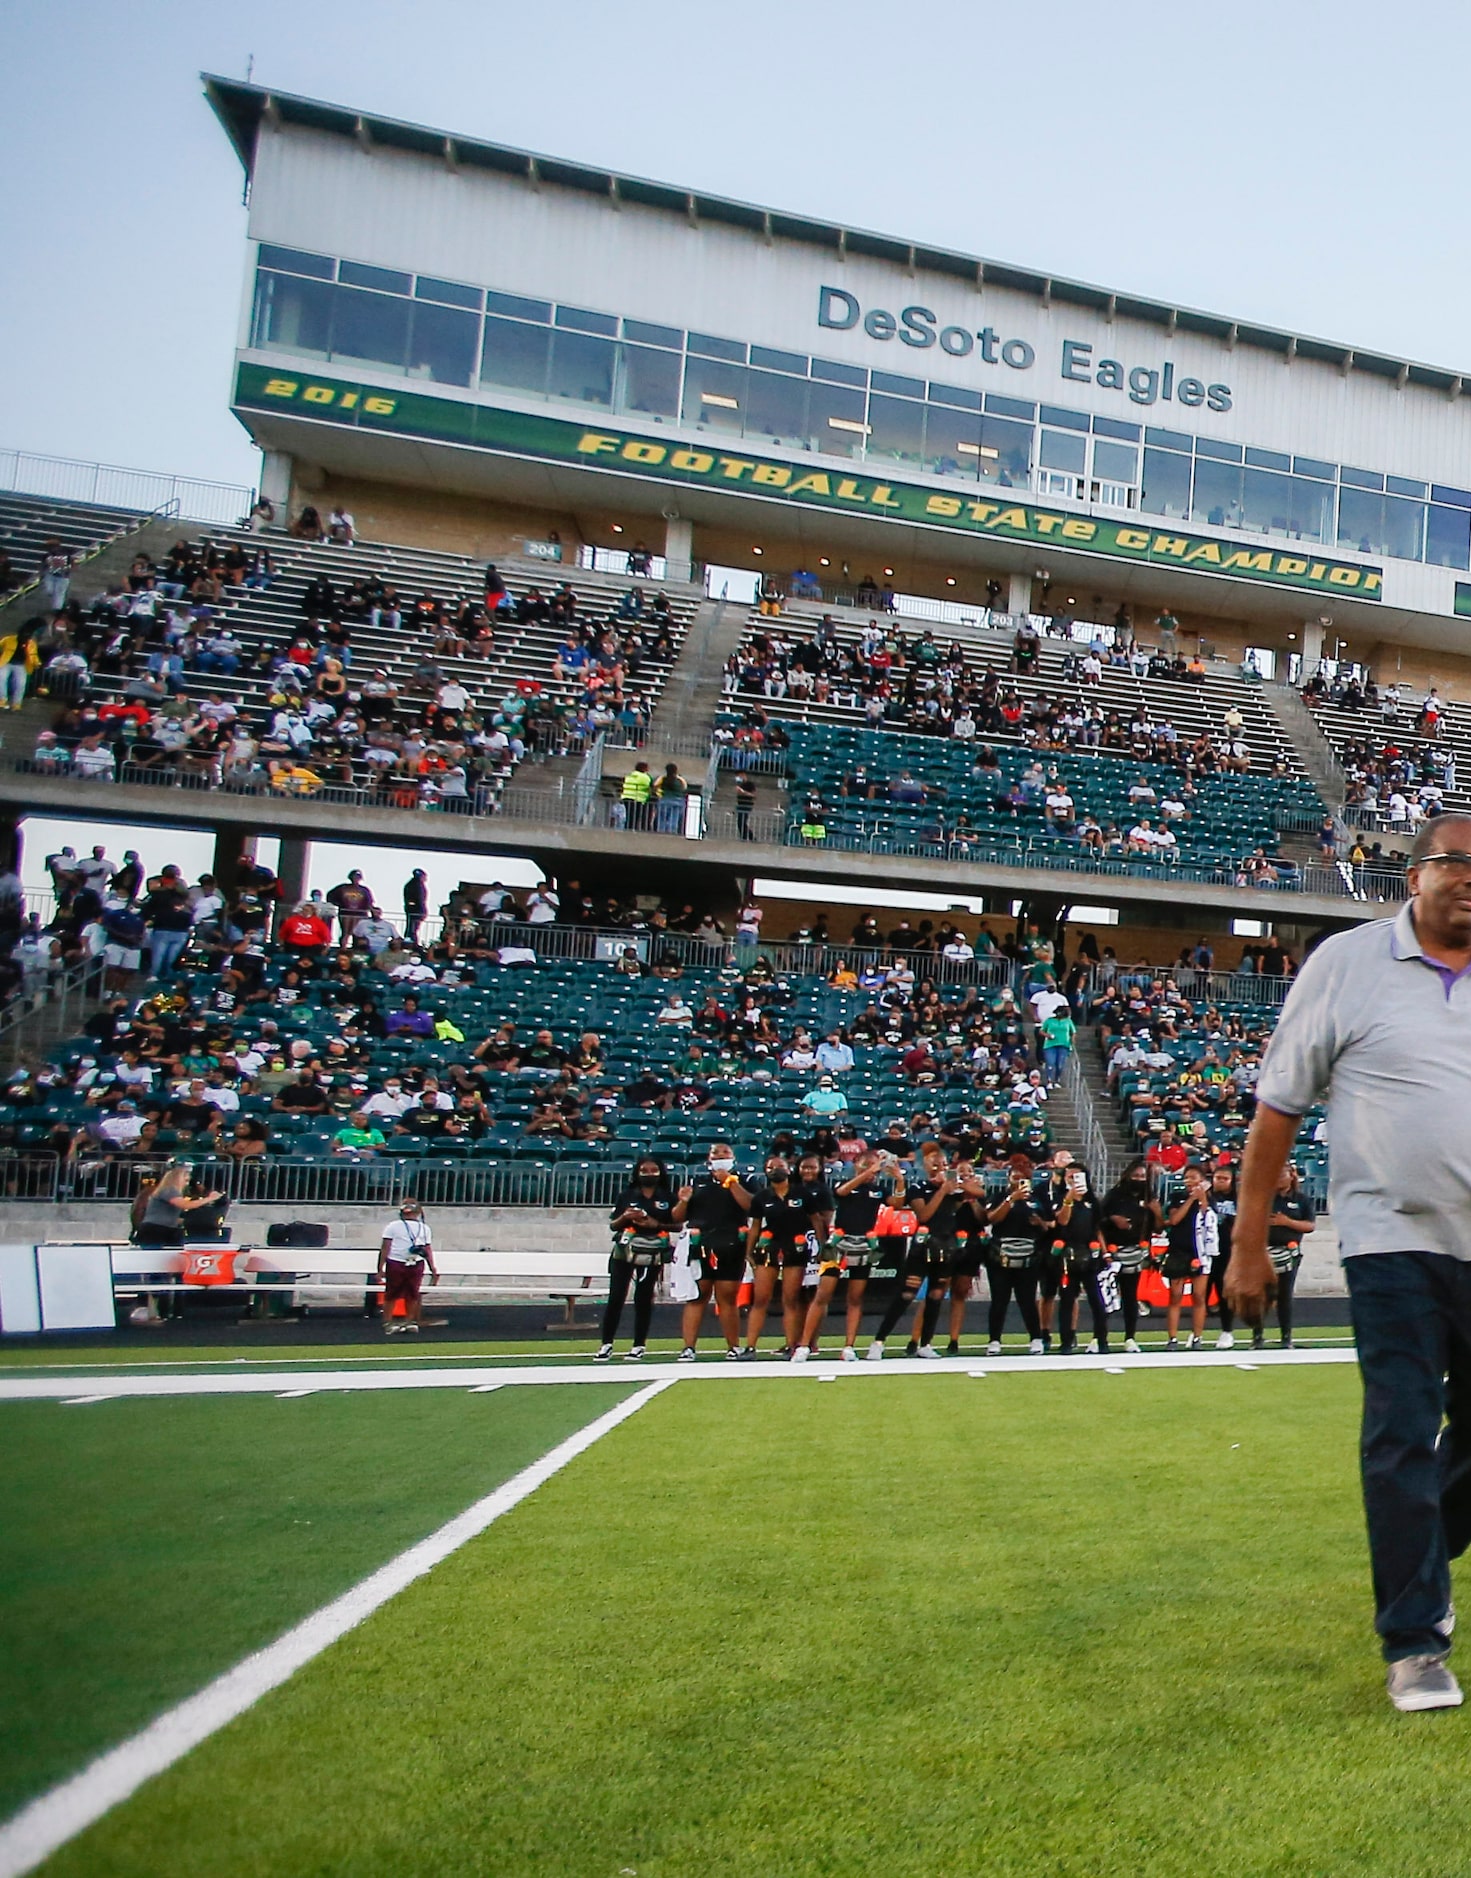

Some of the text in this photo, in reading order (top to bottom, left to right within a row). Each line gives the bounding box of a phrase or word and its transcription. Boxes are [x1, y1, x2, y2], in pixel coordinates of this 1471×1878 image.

[818, 285, 1234, 412] DeSoto Eagles
[263, 379, 397, 415] 2016
[577, 433, 900, 507] FOOTBALL
[925, 494, 1097, 541] STATE
[528, 543, 555, 557] 204
[991, 614, 1013, 627] 203
[197, 1255, 212, 1268] G
